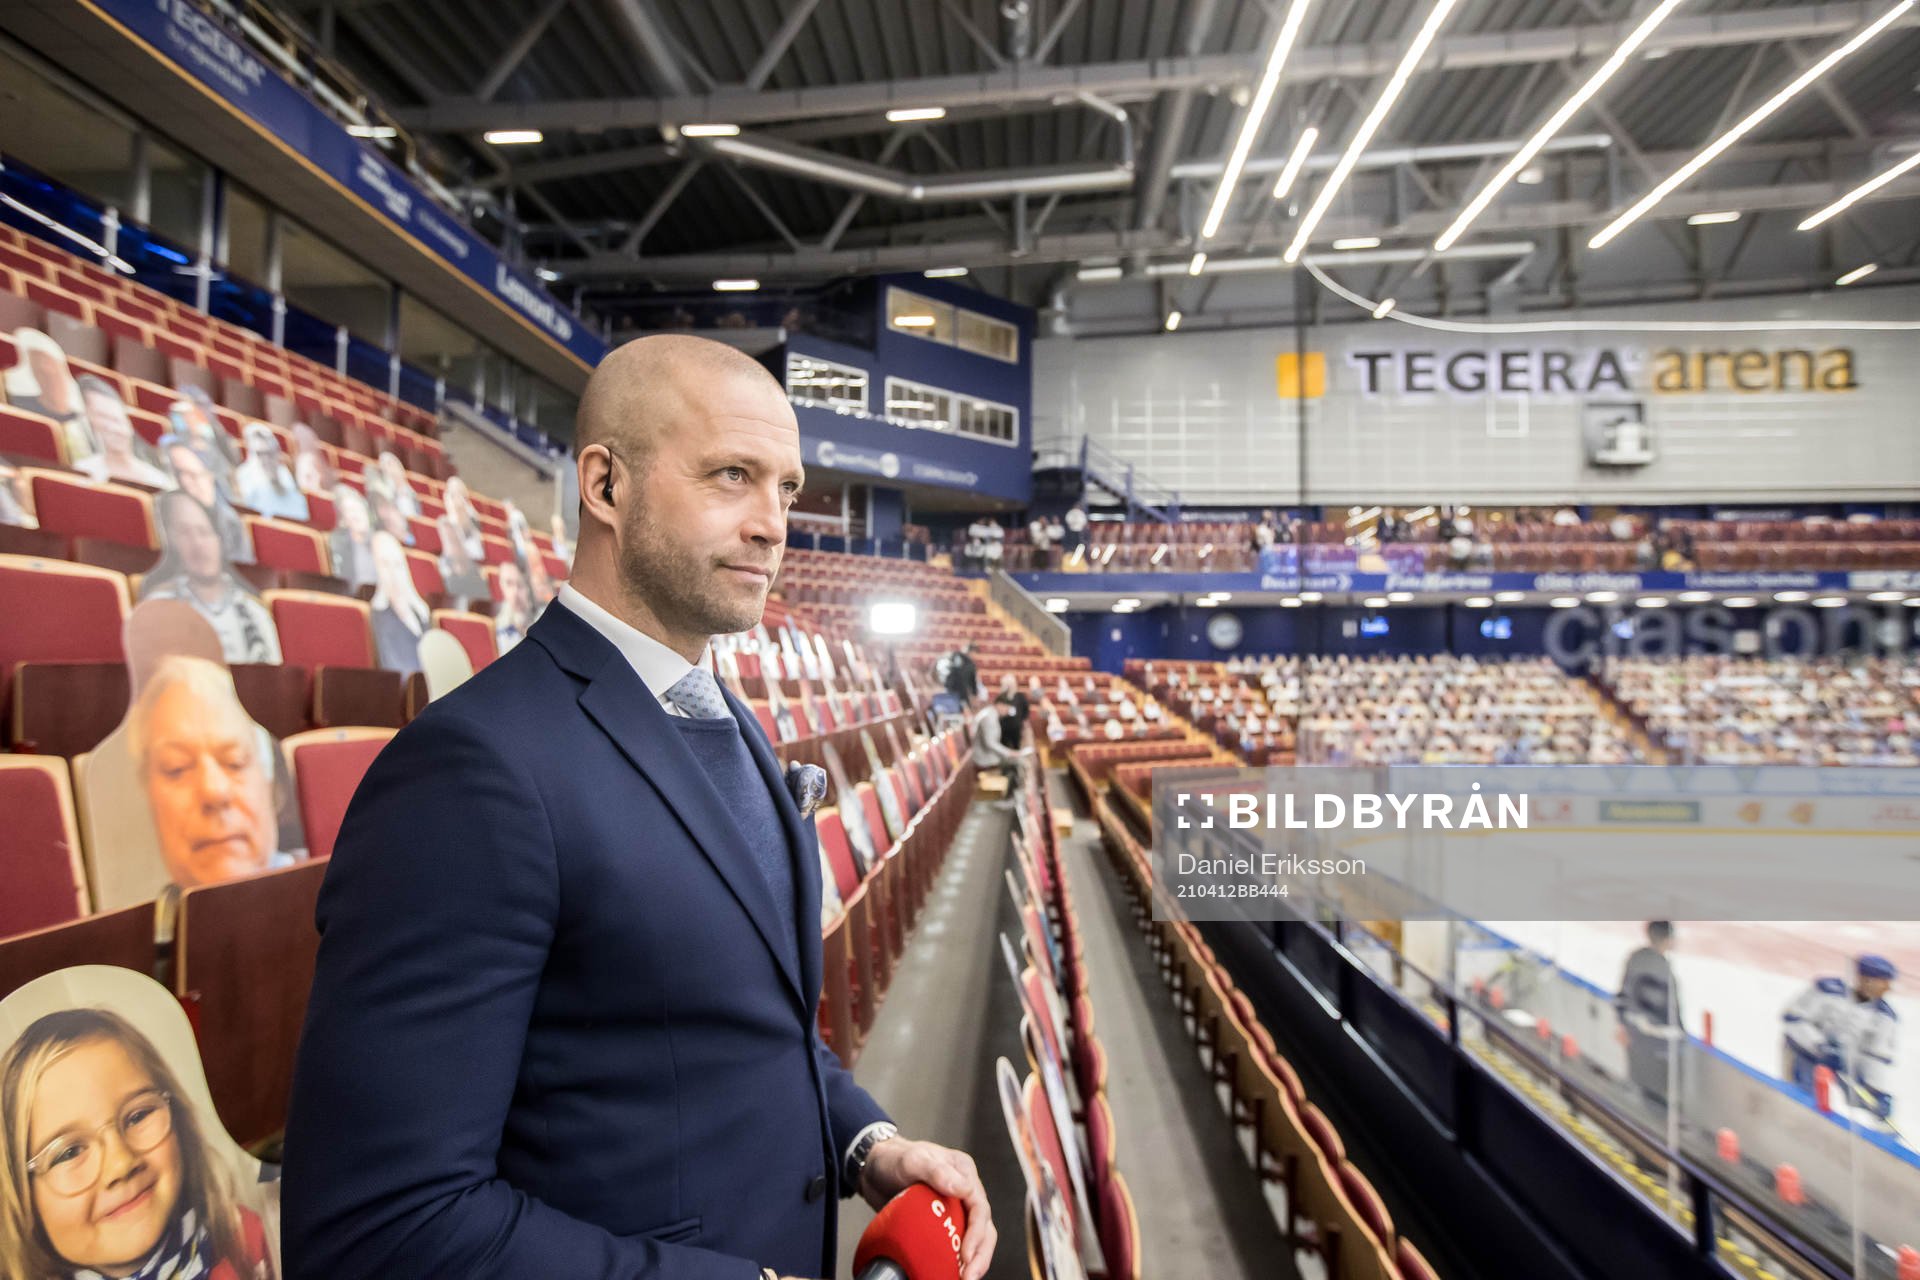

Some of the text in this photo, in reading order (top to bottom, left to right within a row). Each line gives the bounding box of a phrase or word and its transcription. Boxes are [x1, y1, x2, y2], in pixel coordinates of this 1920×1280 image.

[1352, 345, 1859, 394] TEGERA arena
[931, 1199, 946, 1218] C
